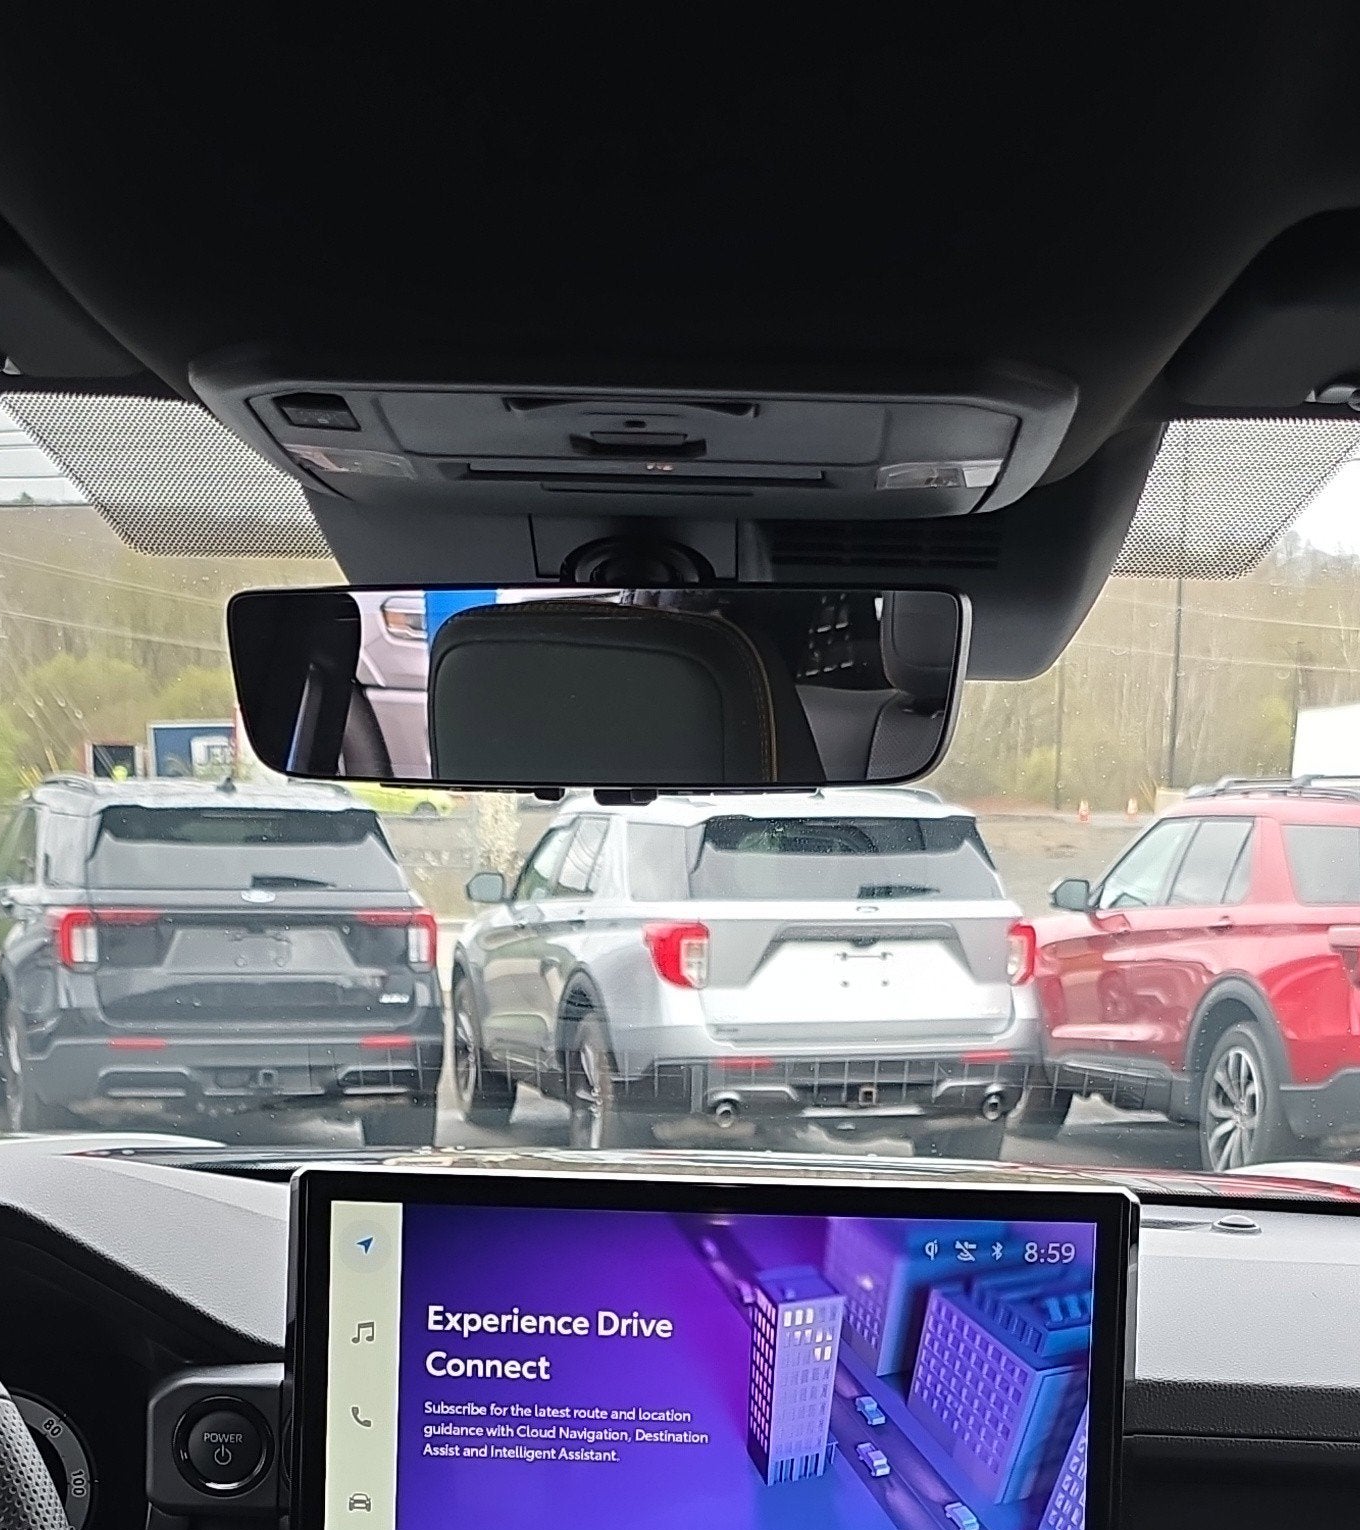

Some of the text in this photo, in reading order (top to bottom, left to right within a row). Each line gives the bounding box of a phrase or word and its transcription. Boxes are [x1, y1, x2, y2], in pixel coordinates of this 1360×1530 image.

[1024, 1242, 1076, 1264] 8:59
[427, 1305, 673, 1338] Experience Drive
[425, 1351, 551, 1380] Connect
[424, 1401, 692, 1423] Subscribe for the latest route and location
[42, 1417, 62, 1438] 80
[203, 1432, 243, 1443] POWER
[423, 1423, 709, 1444] guidance with Cloud Navigation, Destination
[423, 1443, 620, 1462] Assist and Intelligent Assistant.
[70, 1468, 86, 1498] 100
